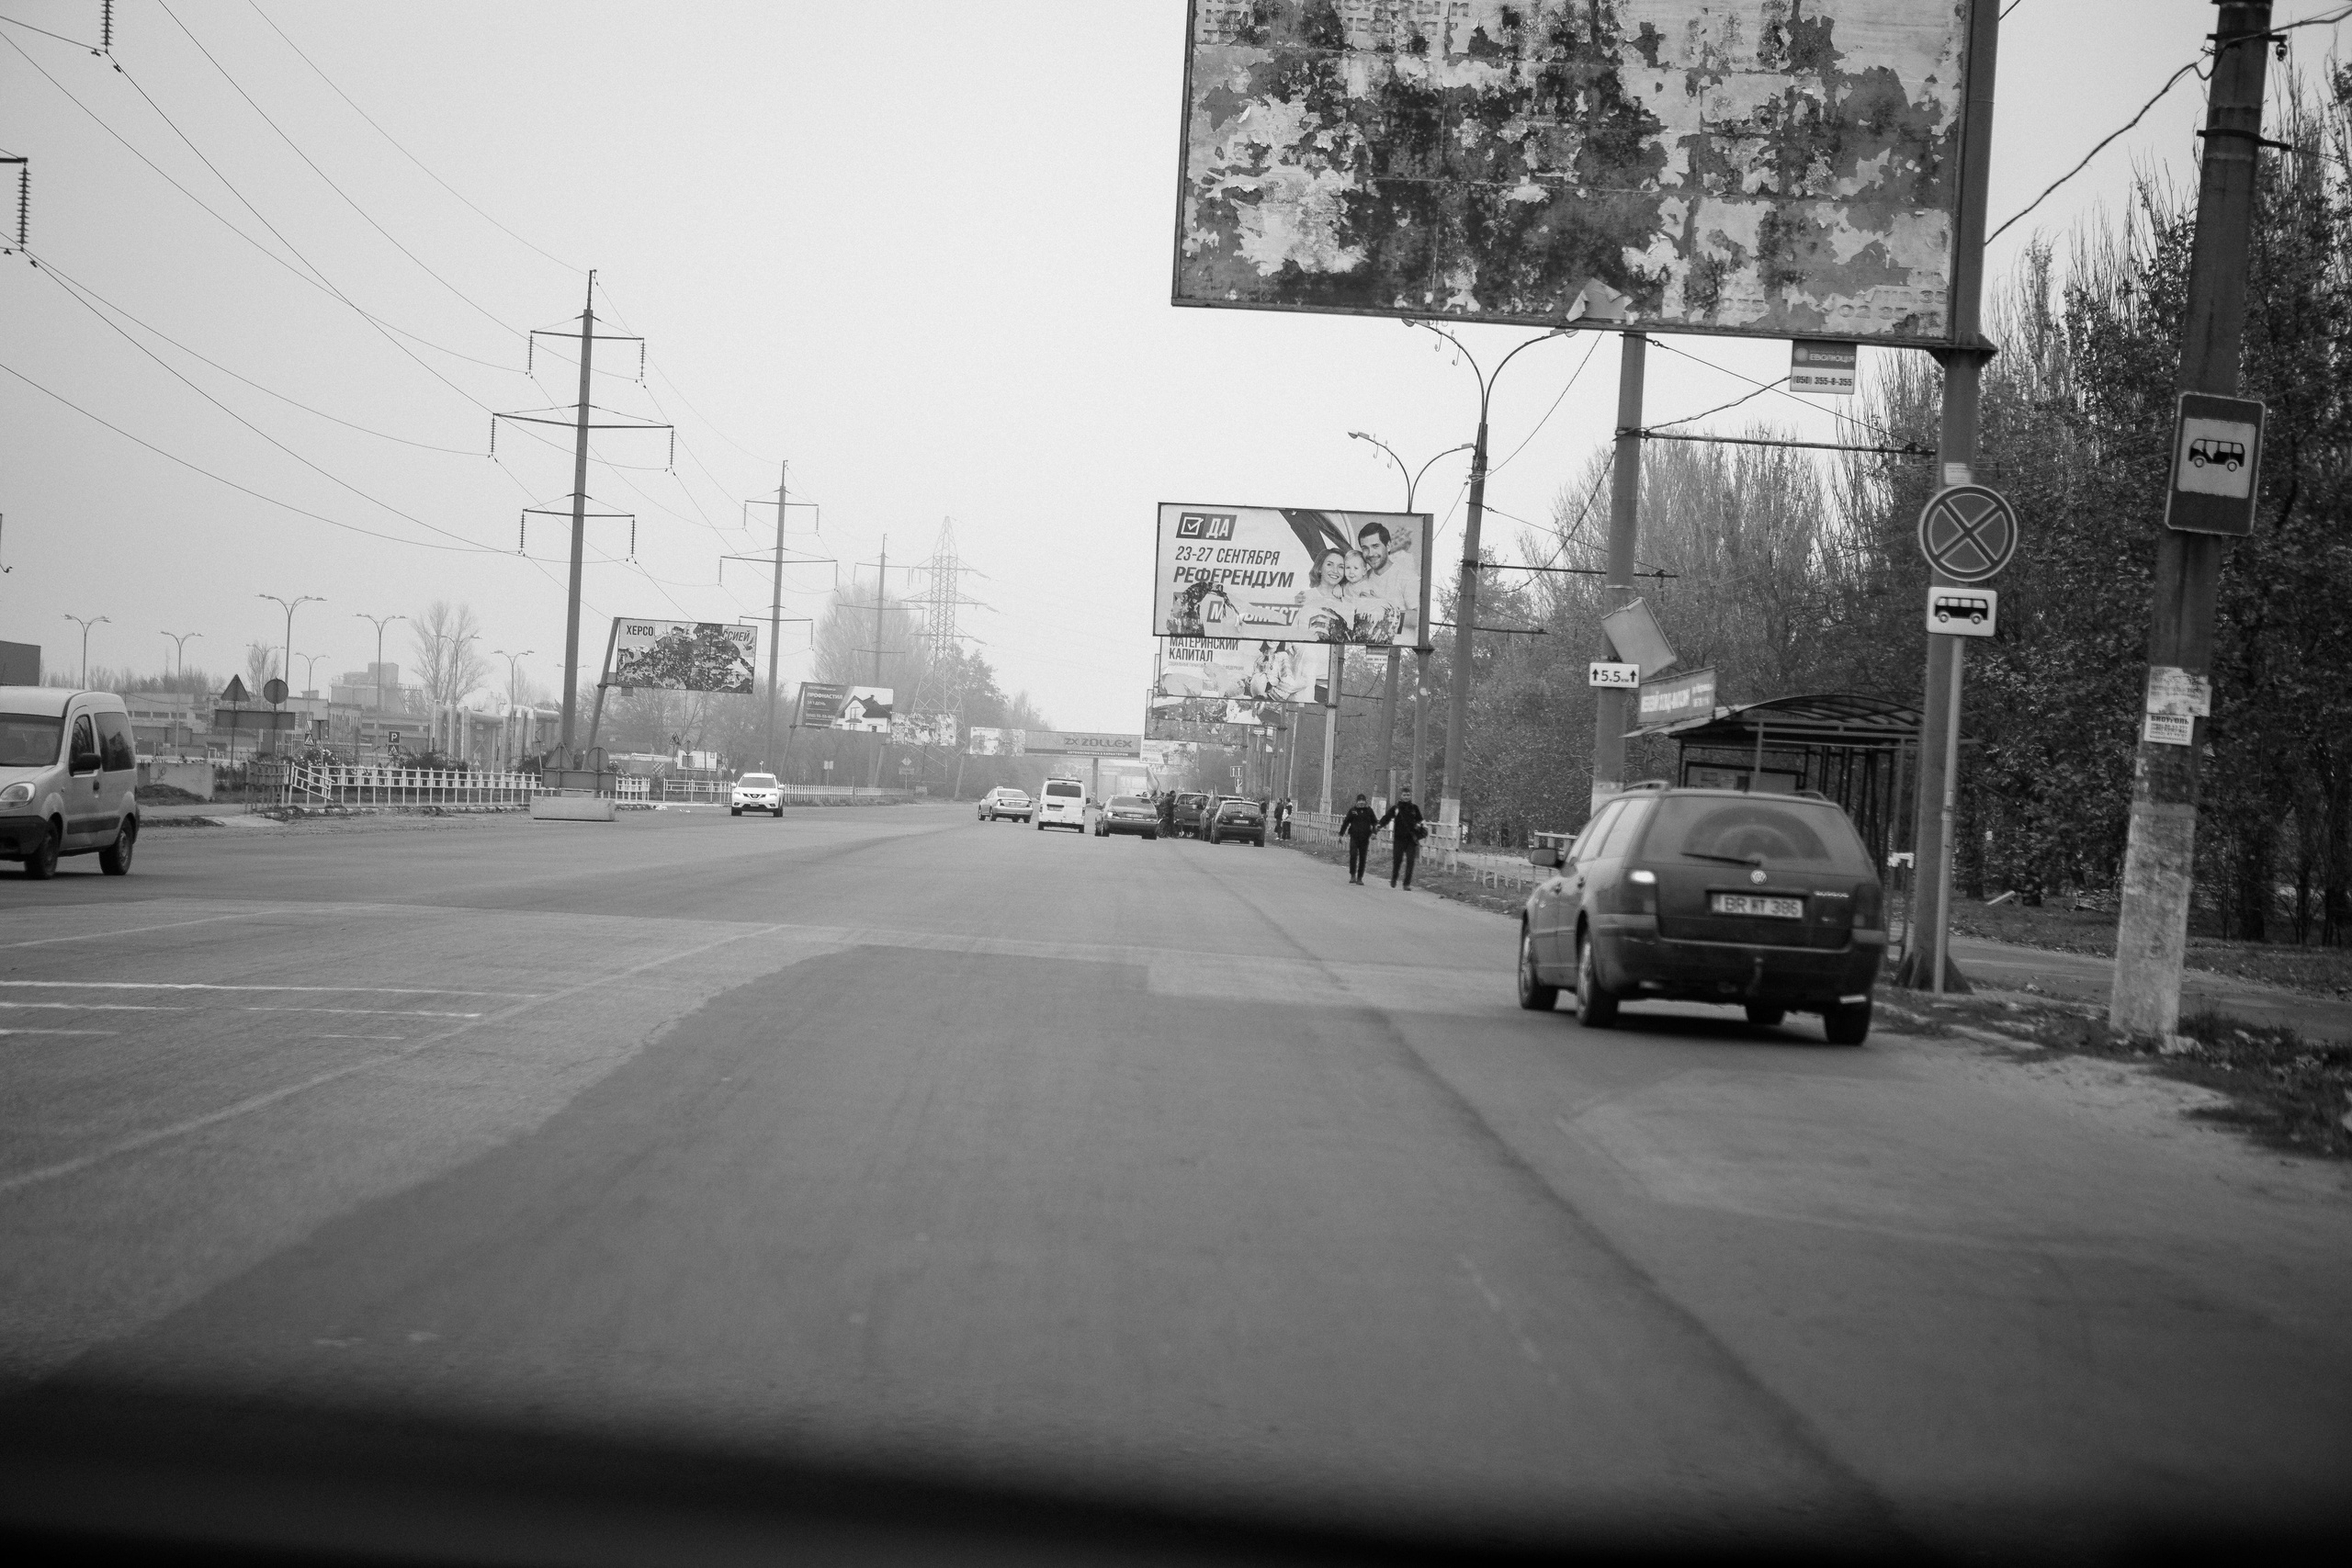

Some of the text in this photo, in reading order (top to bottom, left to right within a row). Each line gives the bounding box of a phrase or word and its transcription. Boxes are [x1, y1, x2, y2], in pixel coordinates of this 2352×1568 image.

[1205, 517, 1230, 539] ДА
[1175, 546, 1281, 566] 23-27 СЕНТЯБРЯ
[1173, 566, 1295, 589] РЕФЕРЕНДУМ
[627, 625, 654, 637] ХЕРСО
[1169, 648, 1214, 662] КАПИТАЛ
[807, 692, 843, 700] ПРОФНАСТИЛ
[391, 733, 398, 741] P
[1081, 738, 1133, 749] ZOLLEX
